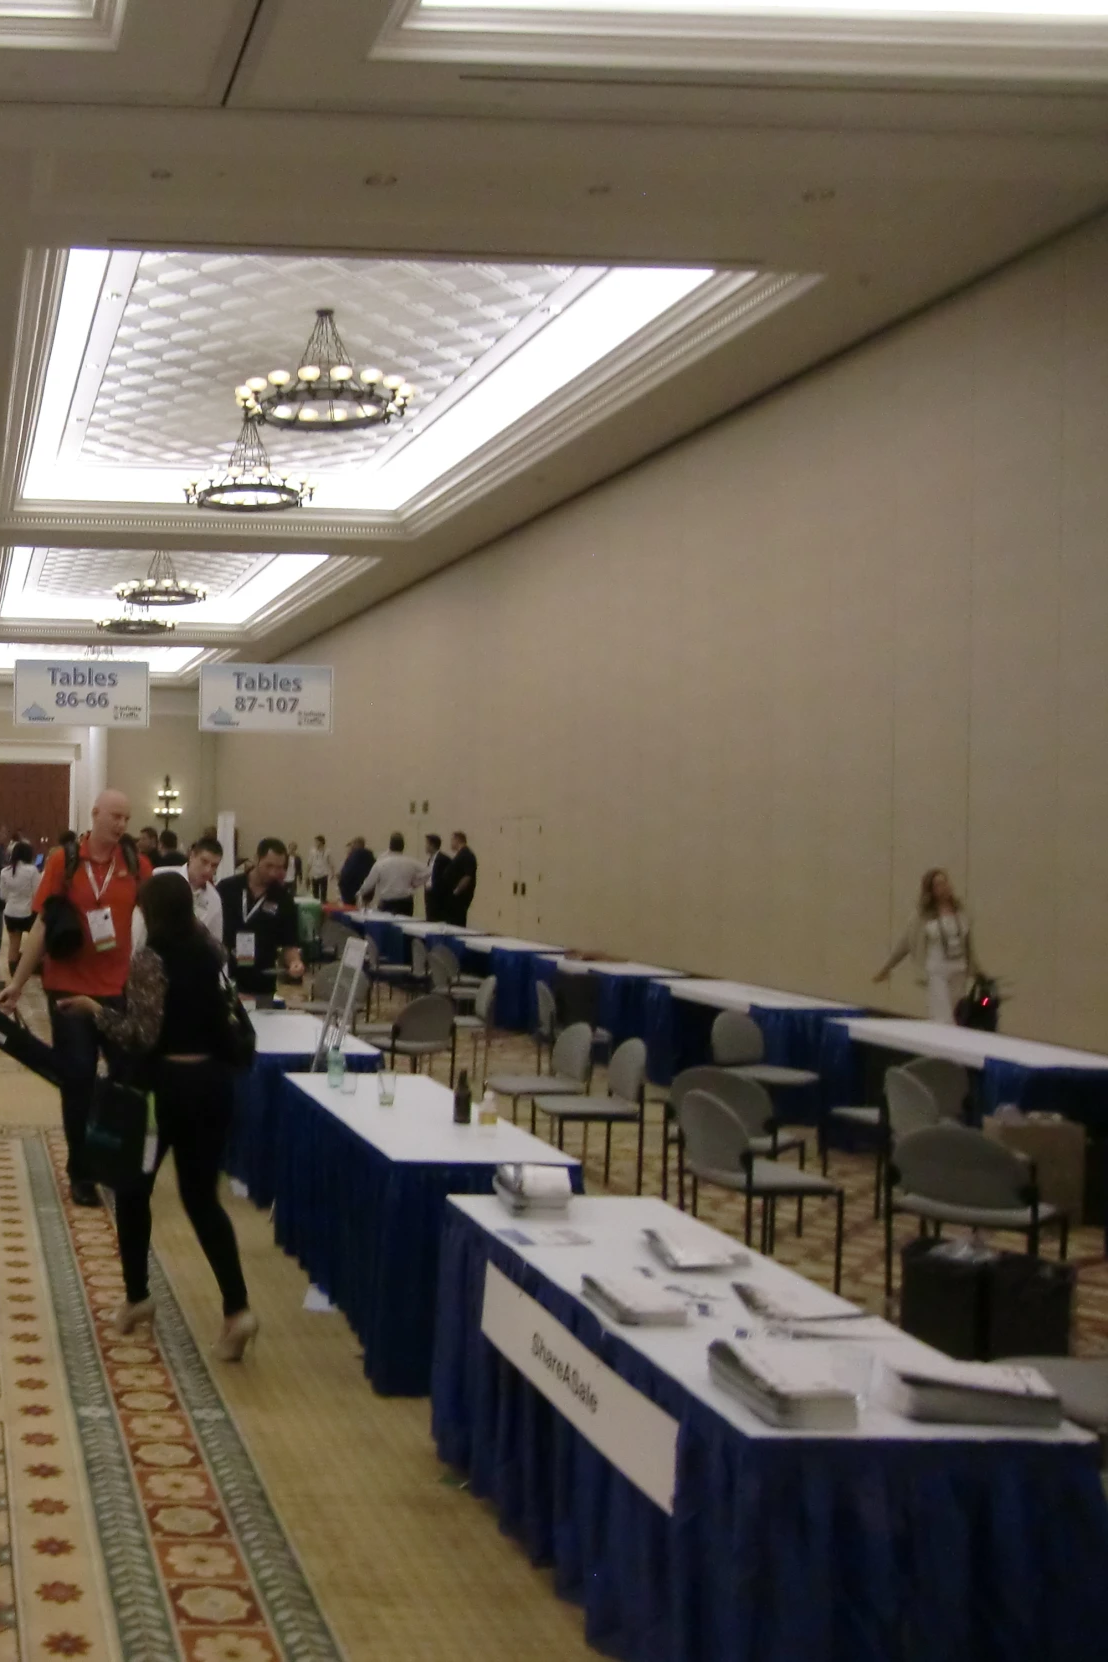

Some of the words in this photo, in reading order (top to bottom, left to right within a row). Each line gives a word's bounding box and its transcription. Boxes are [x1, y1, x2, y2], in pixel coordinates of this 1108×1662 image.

[47, 666, 118, 687] Tables
[232, 671, 303, 692] Tables
[55, 691, 109, 708] 86-66
[234, 696, 299, 713] 87-107
[532, 1332, 598, 1414] ShareASale
